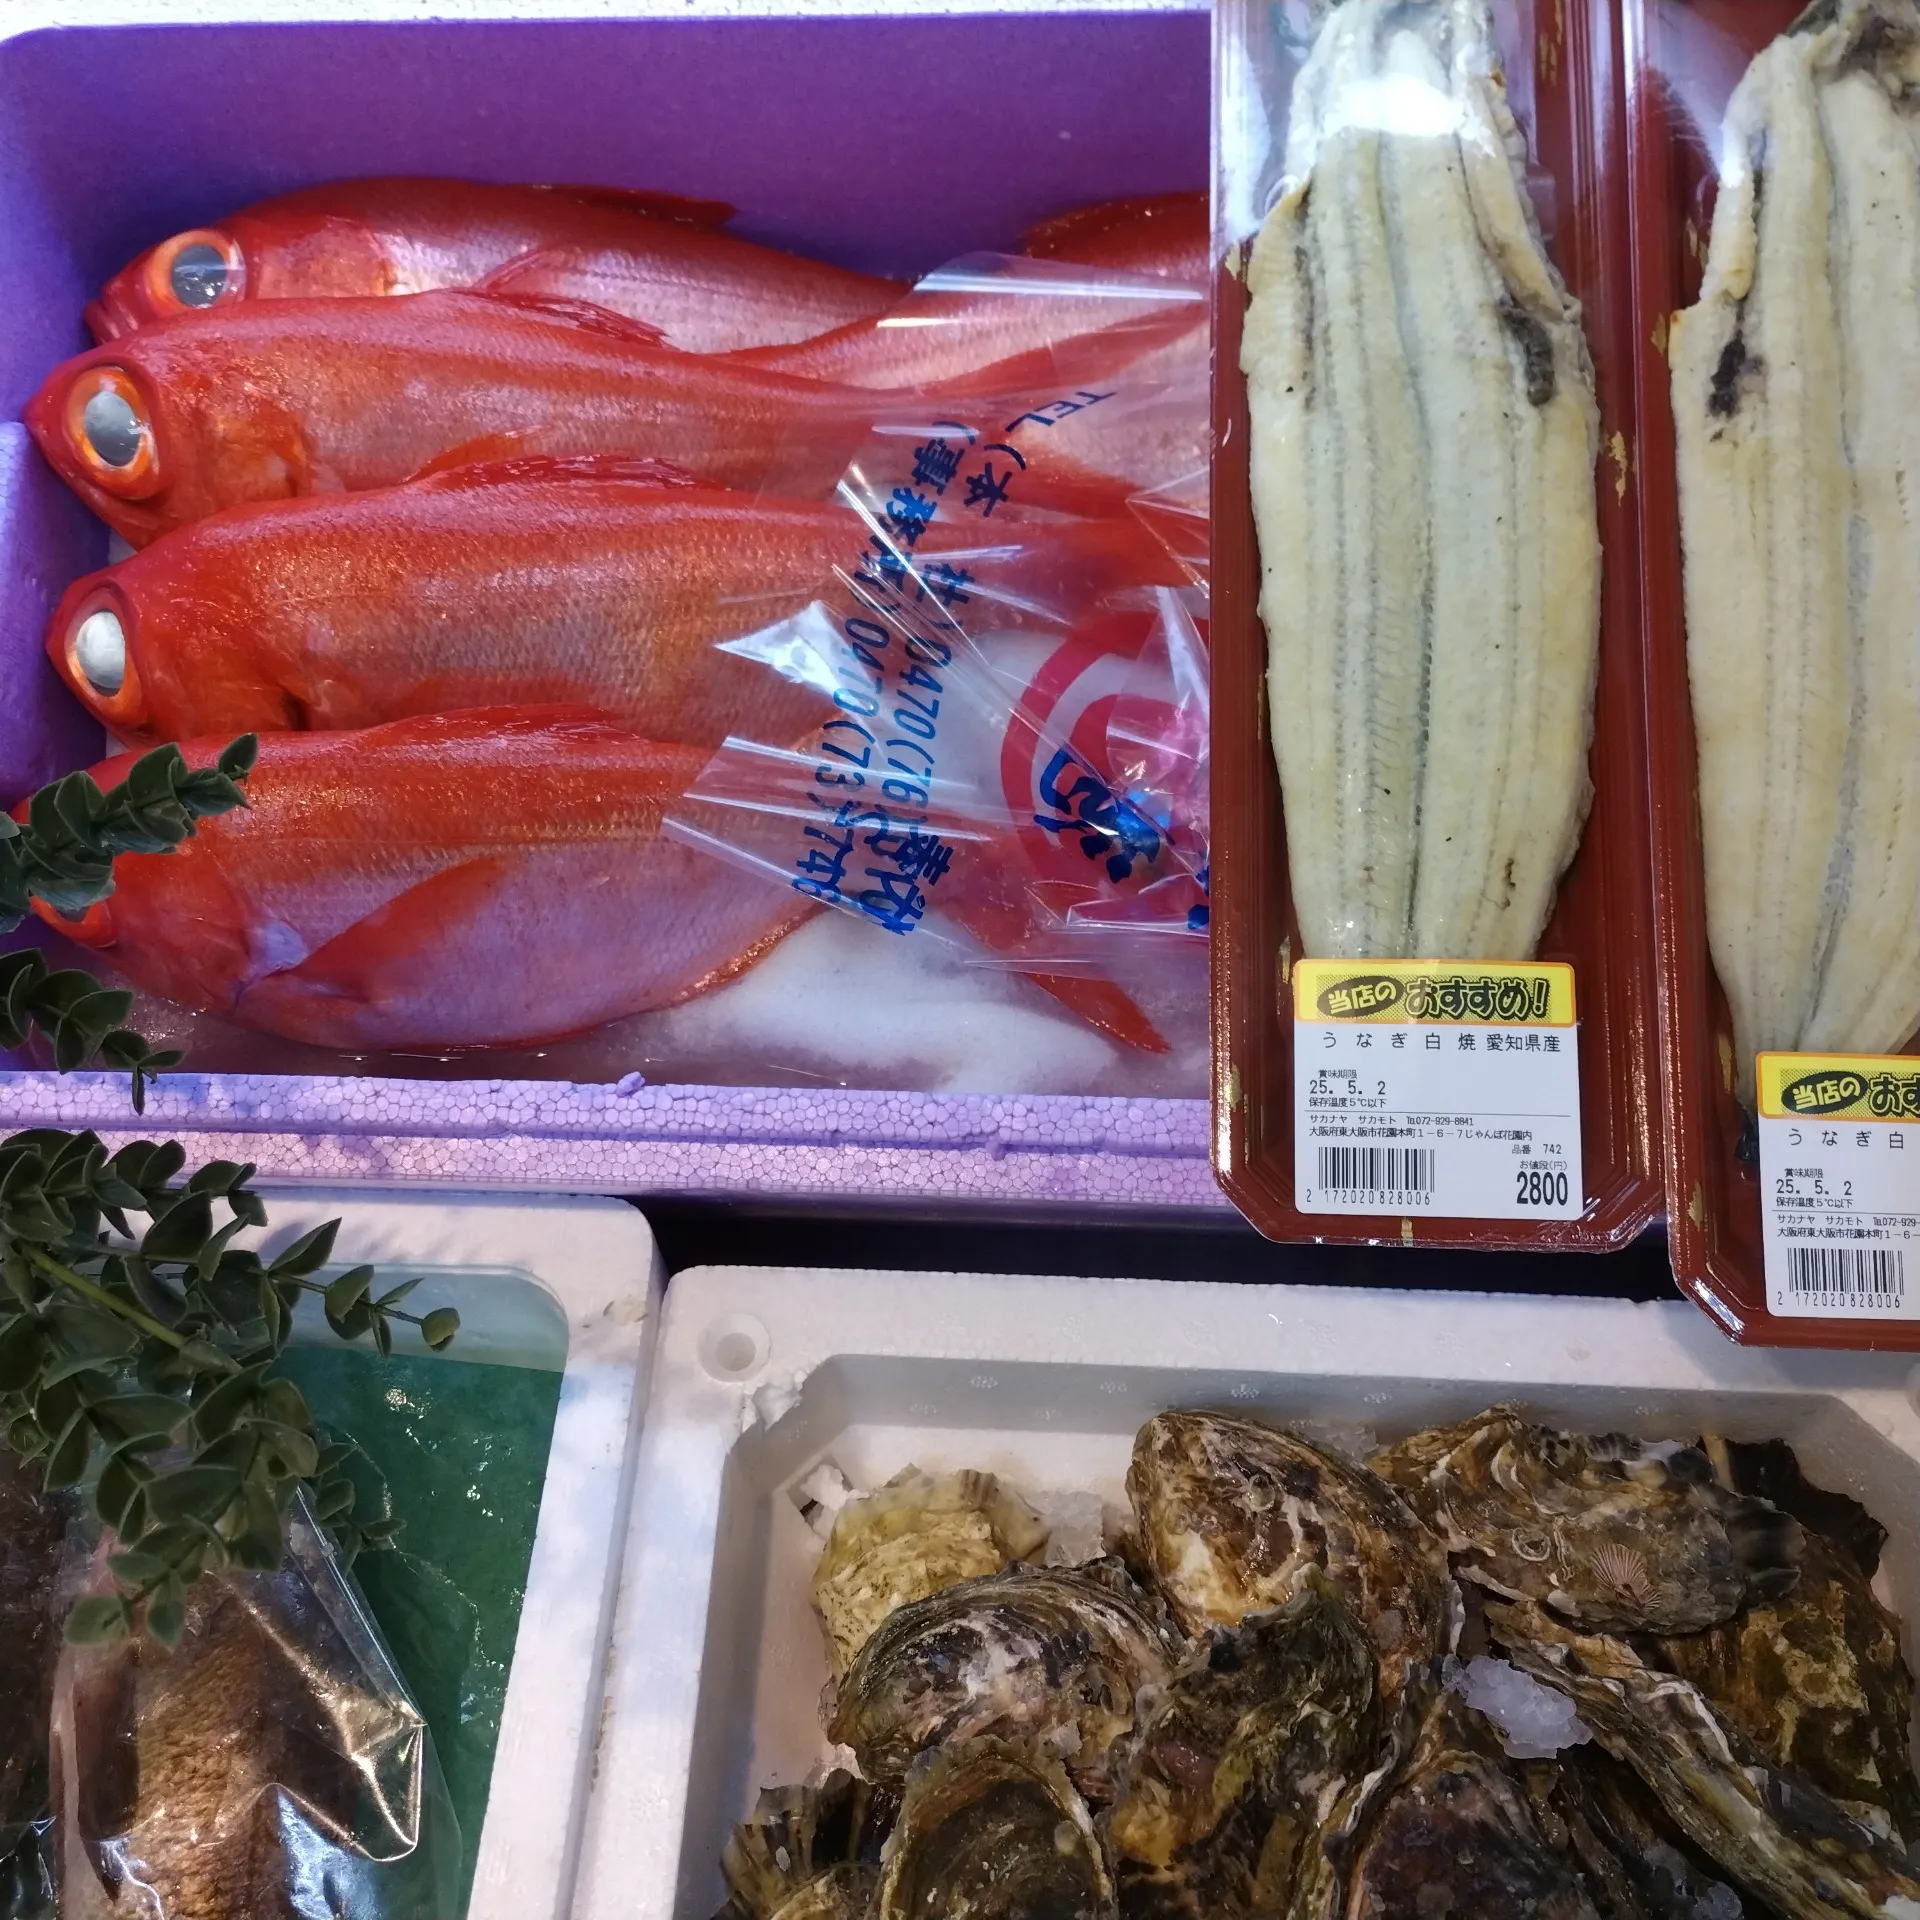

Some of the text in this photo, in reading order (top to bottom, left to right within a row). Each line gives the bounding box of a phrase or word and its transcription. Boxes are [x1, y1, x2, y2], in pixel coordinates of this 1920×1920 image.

[1005, 390, 1117, 432] TEL
[1328, 981, 1397, 1014] 当店の
[1318, 1069, 1358, 1079] 賞味期限
[1793, 1077, 1861, 1110] 当店の
[1310, 1114, 1348, 1124] サカナヤ
[1358, 1115, 1397, 1125] サカモト
[1511, 1144, 1562, 1155] 品番 742
[1784, 1168, 1824, 1179] 賞味期限
[1516, 1171, 1568, 1206] 2800
[1777, 1215, 1815, 1225] サカナヤ
[1825, 1216, 1863, 1226] サカモト
